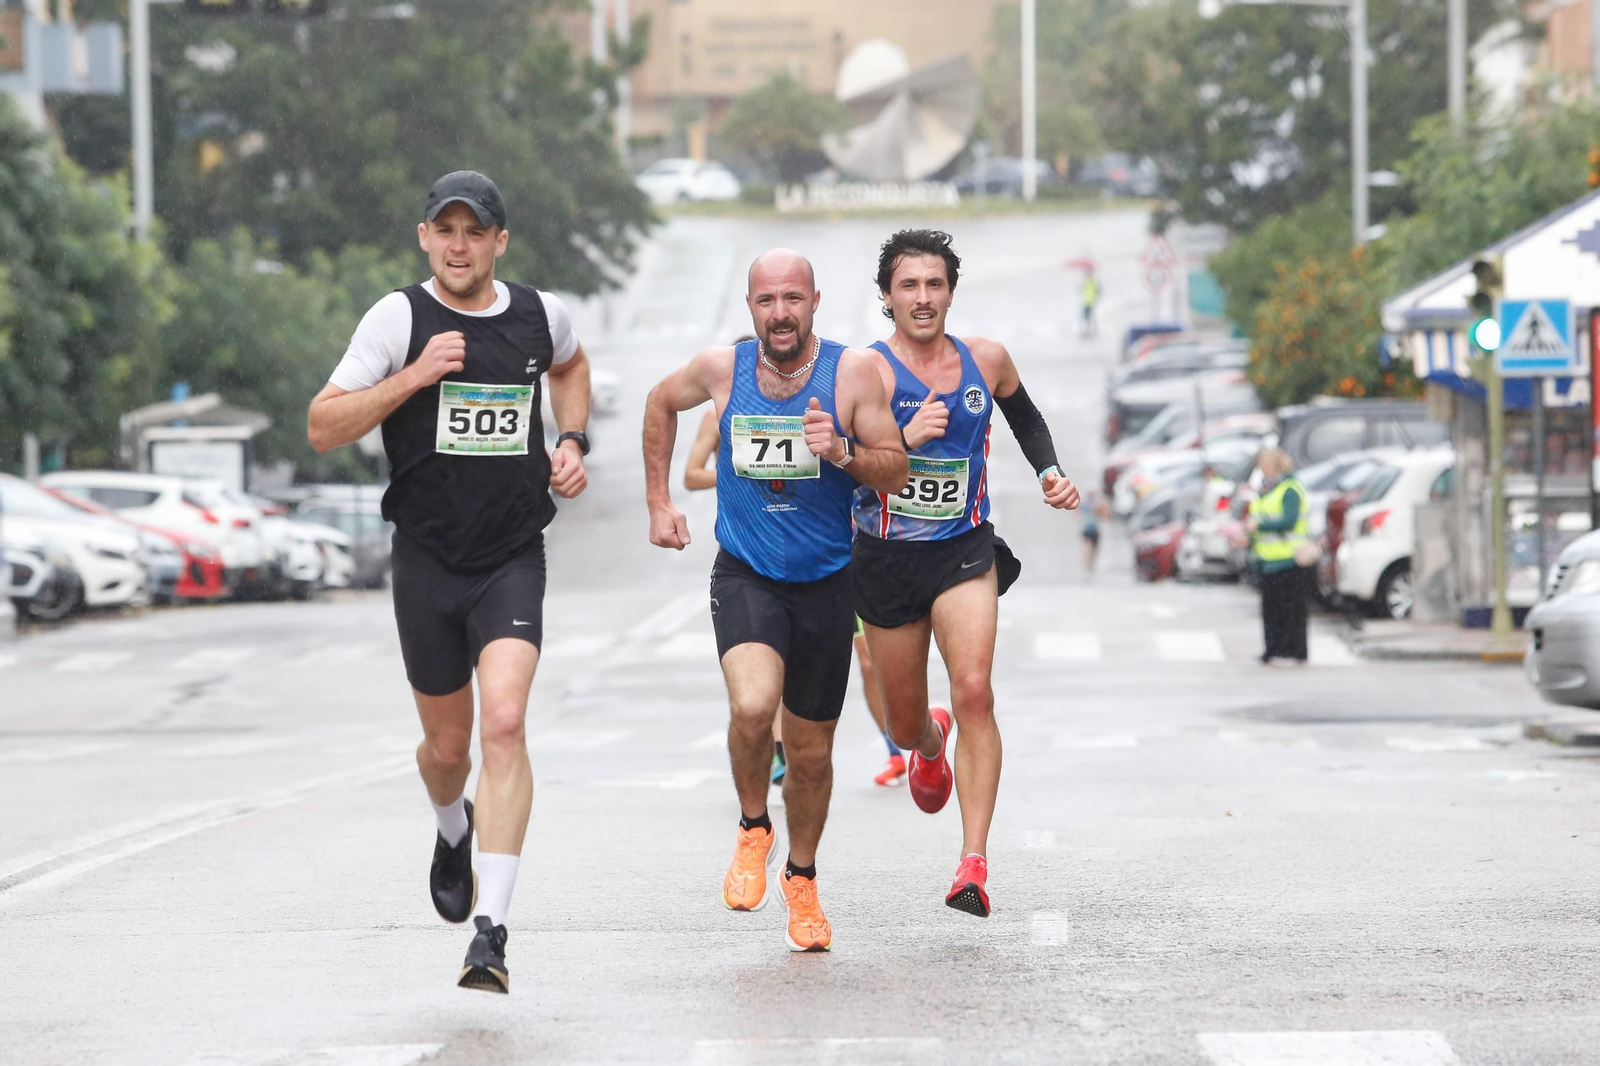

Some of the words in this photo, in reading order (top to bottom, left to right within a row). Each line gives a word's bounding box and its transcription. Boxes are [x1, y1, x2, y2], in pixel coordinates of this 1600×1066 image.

[448, 408, 518, 435] 503
[751, 438, 793, 462] 71
[898, 478, 959, 503] 592
